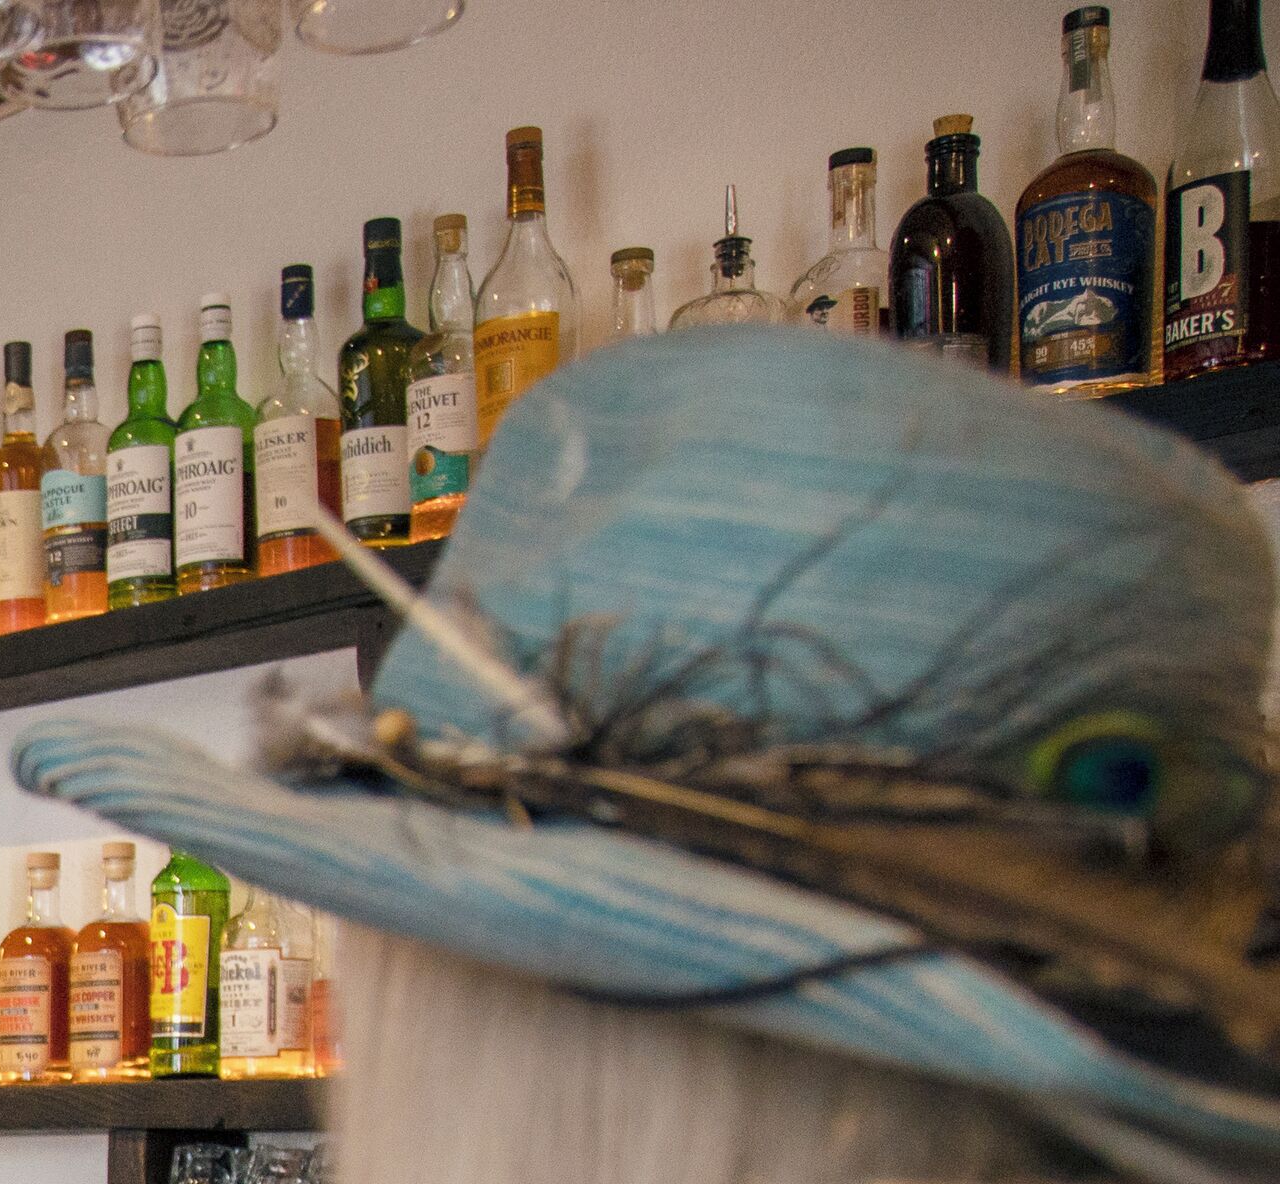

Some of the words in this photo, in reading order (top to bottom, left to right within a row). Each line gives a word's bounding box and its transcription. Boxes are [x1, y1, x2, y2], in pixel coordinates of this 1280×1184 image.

[1023, 201, 1114, 248] BODEGA
[1180, 184, 1225, 302] B
[1023, 236, 1070, 272] CAT
[1052, 276, 1078, 291] RYE
[1079, 276, 1135, 296] WHISKEY
[1165, 309, 1235, 346] BAKER'S
[415, 385, 432, 399] THE
[416, 412, 432, 430] 12
[184, 500, 198, 520] 10
[50, 550, 62, 563] 12
